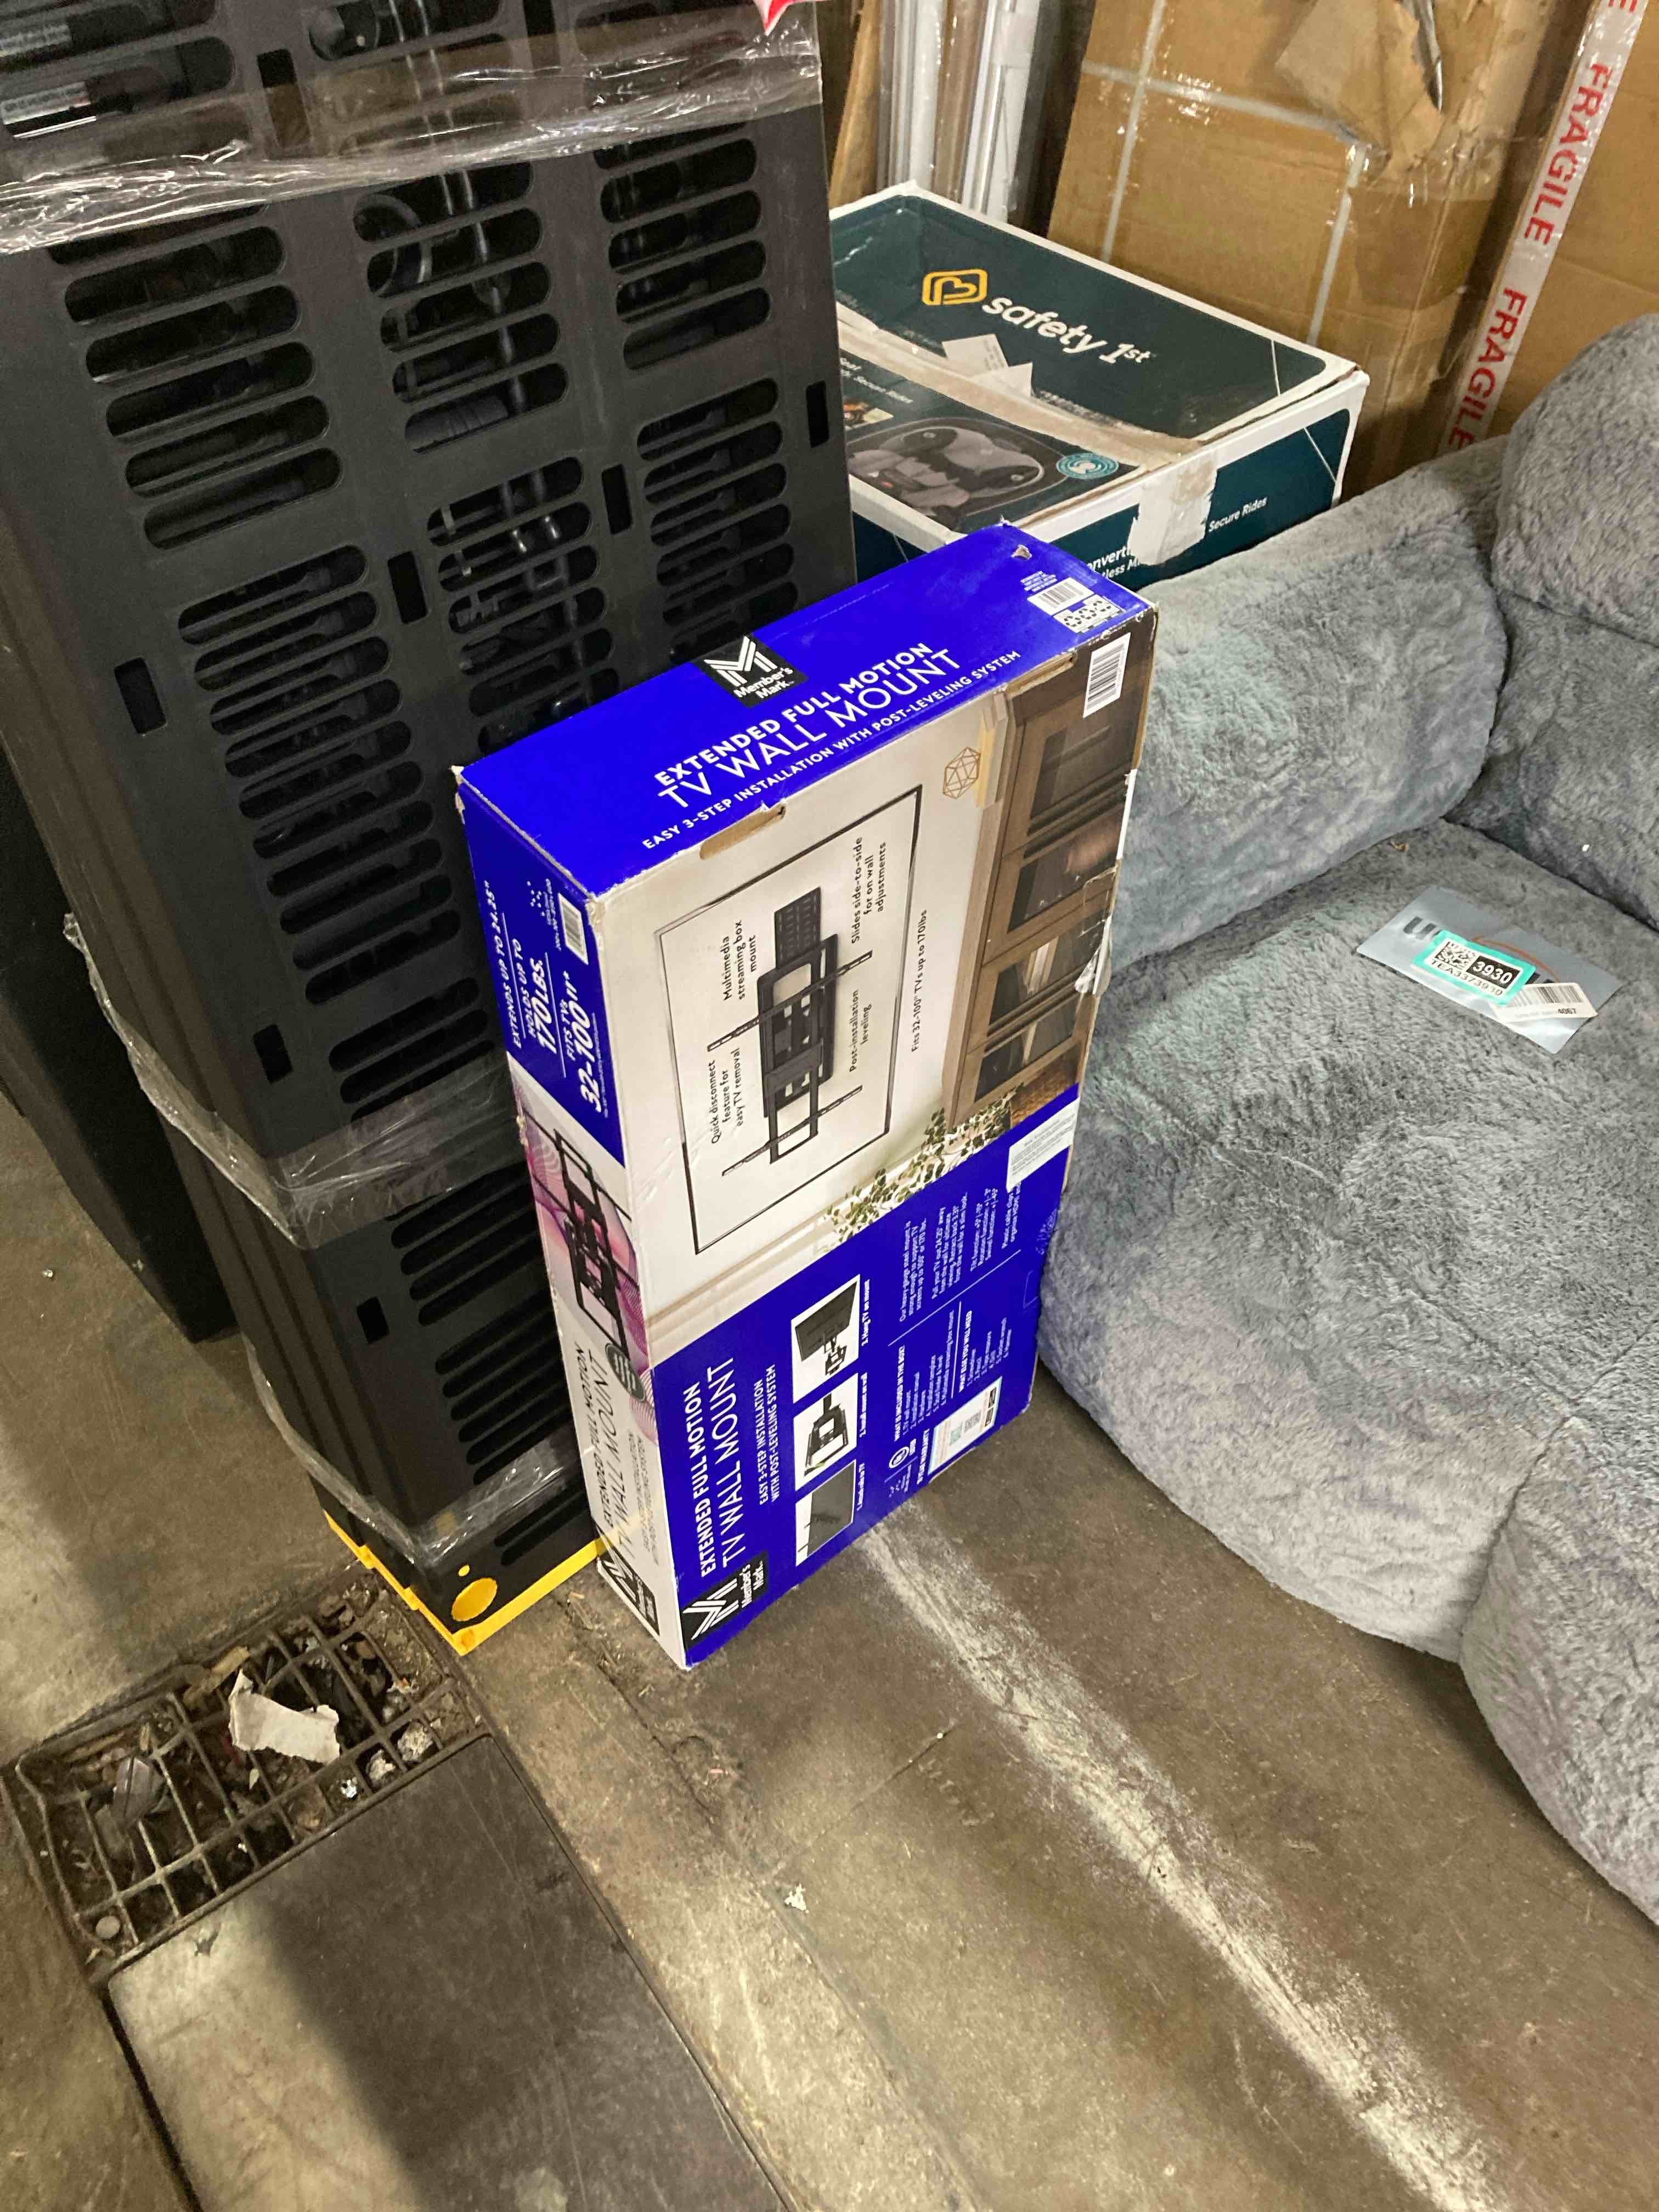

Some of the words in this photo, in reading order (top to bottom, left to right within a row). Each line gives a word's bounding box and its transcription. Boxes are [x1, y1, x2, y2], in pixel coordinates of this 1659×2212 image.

[1525, 62, 1613, 245] FRAGILE
[982, 297, 1107, 354] safety
[1448, 287, 1527, 448] FRAGILE
[1209, 510, 1240, 532] Secure
[1242, 497, 1267, 516] Rides
[734, 668, 793, 697] Member's
[654, 720, 780, 786] EXTENDED
[782, 692, 841, 722] FULL
[839, 643, 939, 693] MOTION
[658, 772, 711, 807] TV
[715, 724, 827, 777] WALL
[821, 649, 960, 727] MOUNT
[642, 825, 680, 848] EASY
[682, 799, 731, 828] 3-STEP
[734, 748, 834, 801] INSTALLATION
[833, 729, 872, 749] WITH
[872, 676, 972, 730] POST-LEVELING
[972, 651, 1020, 679] SYSTEM
[853, 838, 862, 908] side-to-side
[865, 855, 873, 879] wall
[876, 843, 886, 912] adjustments
[864, 899, 872, 915] for
[867, 881, 872, 894] on
[494, 935, 505, 956] TO
[733, 921, 742, 944] box
[851, 911, 860, 944] Slides
[918, 910, 926, 944] 170lbs
[512, 939, 523, 960] TO
[720, 936, 732, 1001] Multimedia
[918, 945, 924, 956] to
[918, 958, 926, 971] up
[499, 959, 509, 980] UP
[517, 963, 527, 984] UP
[530, 958, 549, 1003] LBS.
[735, 943, 746, 1000] streaming
[915, 973, 923, 994] TVs
[1472, 961, 1513, 984] 3930
[504, 982, 521, 1048] EXTENDS
[521, 987, 536, 1037] HOLDS
[531, 997, 556, 1053] 170
[560, 1000, 570, 1024] TVs
[849, 990, 858, 1072] Post-installation
[860, 1004, 872, 1045] leveling
[563, 1027, 575, 1060] FITS
[709, 1060, 718, 1113] disconnect
[720, 1071, 728, 1086] for
[731, 1048, 741, 1088] removal
[722, 1086, 731, 1122] feature
[733, 1092, 742, 1106] TV
[737, 1106, 745, 1126] easy
[710, 1115, 721, 1143] Quick
[862, 1308, 868, 1322] TV
[575, 1342, 594, 1413] MOTION
[766, 1365, 776, 1404] SYSTEM
[589, 1349, 620, 1462] MOUNT
[684, 1382, 705, 1458] MOTION
[707, 1358, 739, 1464] MOUNT
[754, 1379, 765, 1449] INSTALLATION
[587, 1414, 601, 1453] FULL
[768, 1404, 778, 1477] POST-LEVELING
[691, 1455, 709, 1499] FULL
[758, 1451, 767, 1481] 3-STEP
[594, 1453, 613, 1527] EXTENDED
[607, 1462, 628, 1523] WALL
[716, 1460, 743, 1535] WALL
[759, 1481, 768, 1505] EASY
[771, 1476, 779, 1502] WITH
[695, 1498, 716, 1577] EXTENDED
[721, 1533, 746, 1567] TV
[740, 1565, 752, 1607] Member's
